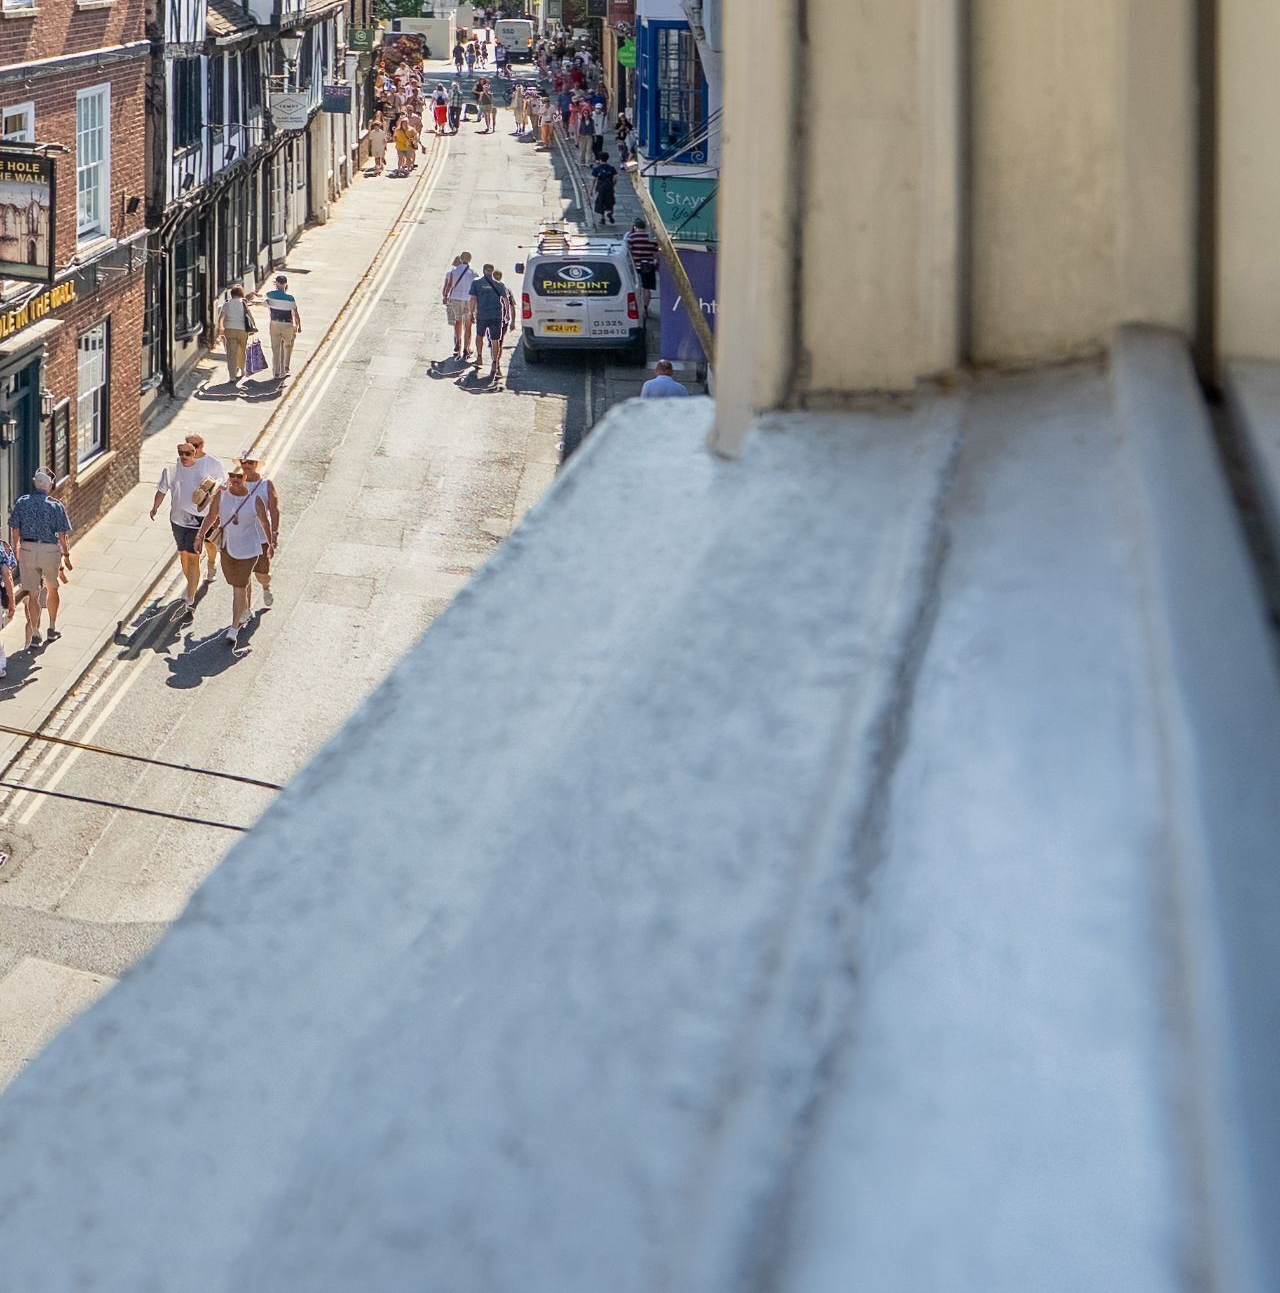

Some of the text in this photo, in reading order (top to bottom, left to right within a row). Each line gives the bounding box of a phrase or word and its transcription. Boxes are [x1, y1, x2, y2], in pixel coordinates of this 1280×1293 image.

[7, 162, 40, 173] HOLE
[14, 172, 48, 185] WALL
[15, 306, 29, 329] IN
[29, 293, 51, 319] THE
[50, 280, 76, 310] WALL
